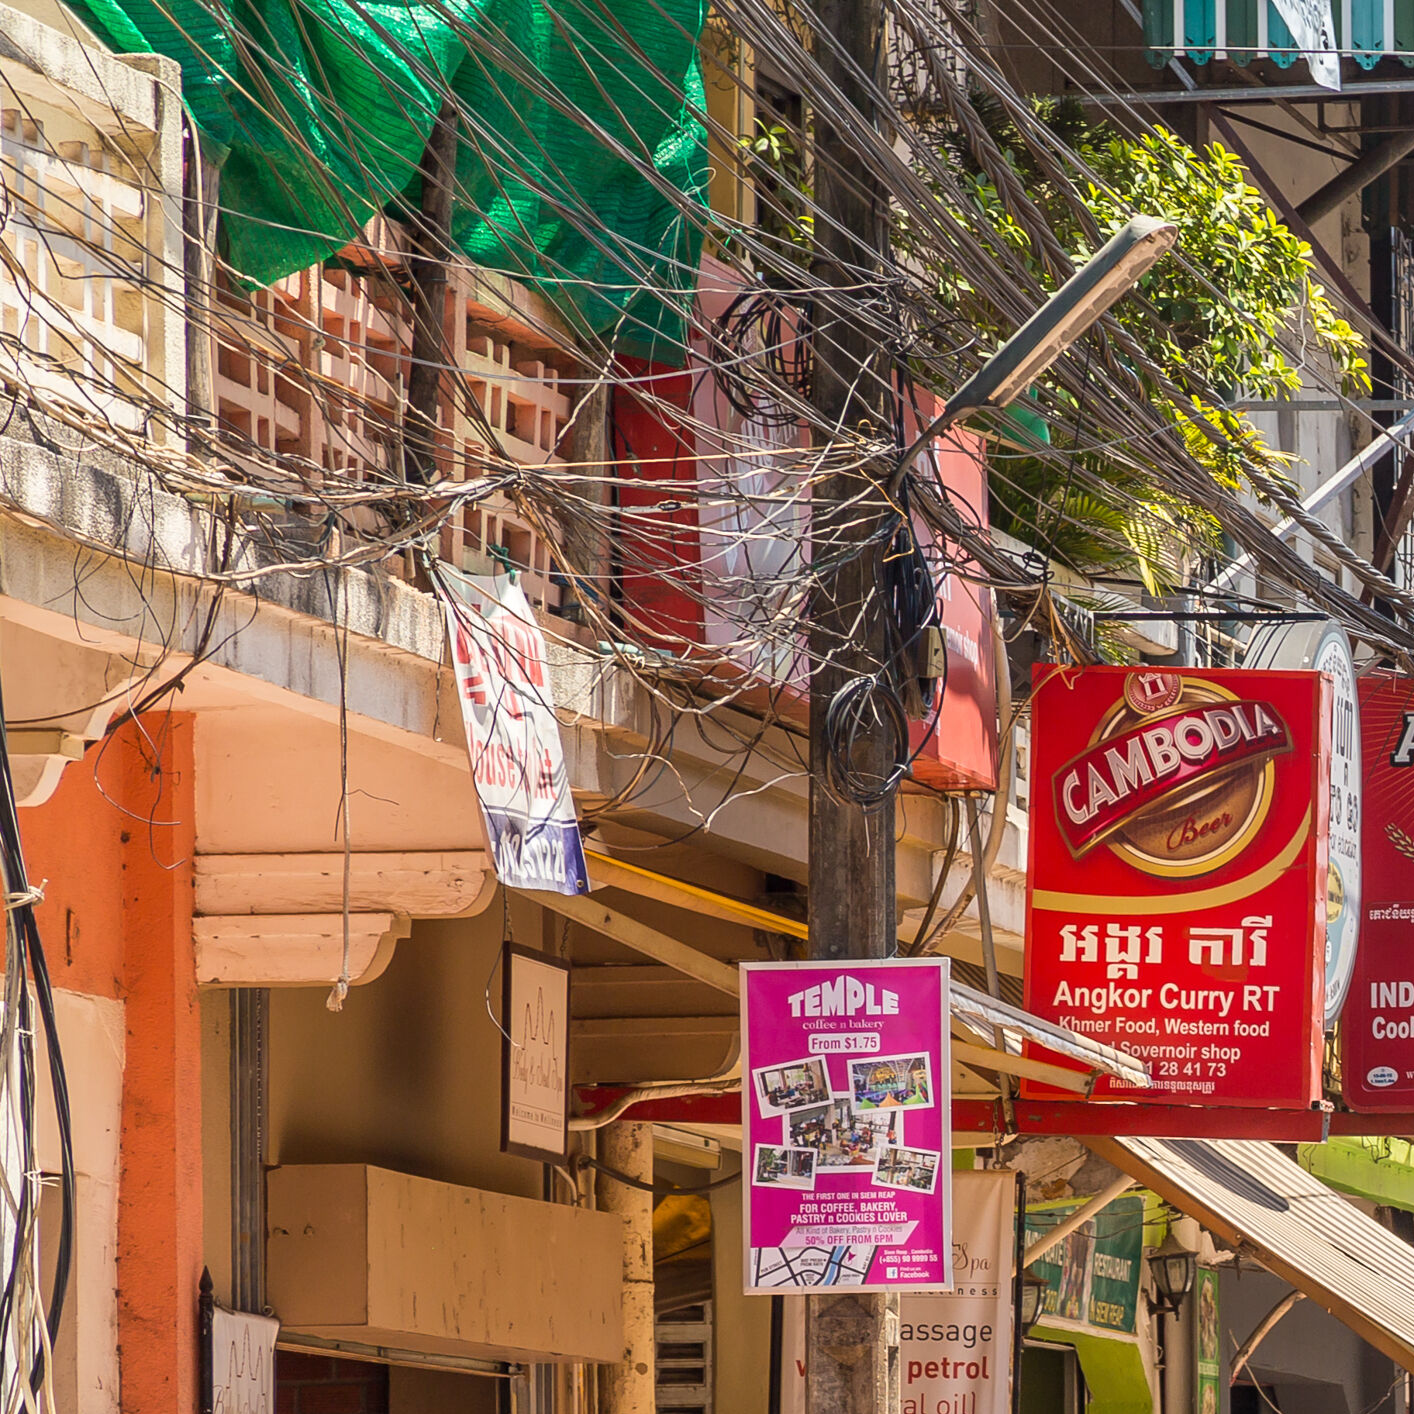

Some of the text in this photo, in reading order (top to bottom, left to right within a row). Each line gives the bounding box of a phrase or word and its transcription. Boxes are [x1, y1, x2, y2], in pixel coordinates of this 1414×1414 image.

[1062, 703, 1283, 826] CAMBODIA
[1166, 810, 1234, 851] Beer
[787, 975, 900, 1018] TEMPLE
[1053, 980, 1281, 1018] Angkor Curry RT
[802, 1018, 885, 1031] coffee n bakery
[1058, 1016, 1270, 1038] Khmer Food, Western food
[811, 1036, 878, 1051] From $1.75
[1119, 1041, 1242, 1064] Sovernoir shop
[1158, 1062, 1227, 1078] 28 41 73
[802, 1193, 814, 1201] THE
[816, 1192, 834, 1200] FIRST
[836, 1192, 851, 1200] ONE
[860, 1191, 876, 1199] SIEM
[878, 1191, 896, 1199] REAP
[800, 1203, 818, 1213] FOR
[790, 1213, 826, 1224] PASTRY
[835, 1213, 875, 1223] COOKIES
[878, 1212, 908, 1222] LOVER
[806, 1226, 821, 1234] Kind
[878, 1225, 903, 1233] Cookies
[805, 1234, 894, 1246] 50% OFF FROM 6PM
[900, 1323, 993, 1349] assage
[907, 1356, 990, 1385] petrol
